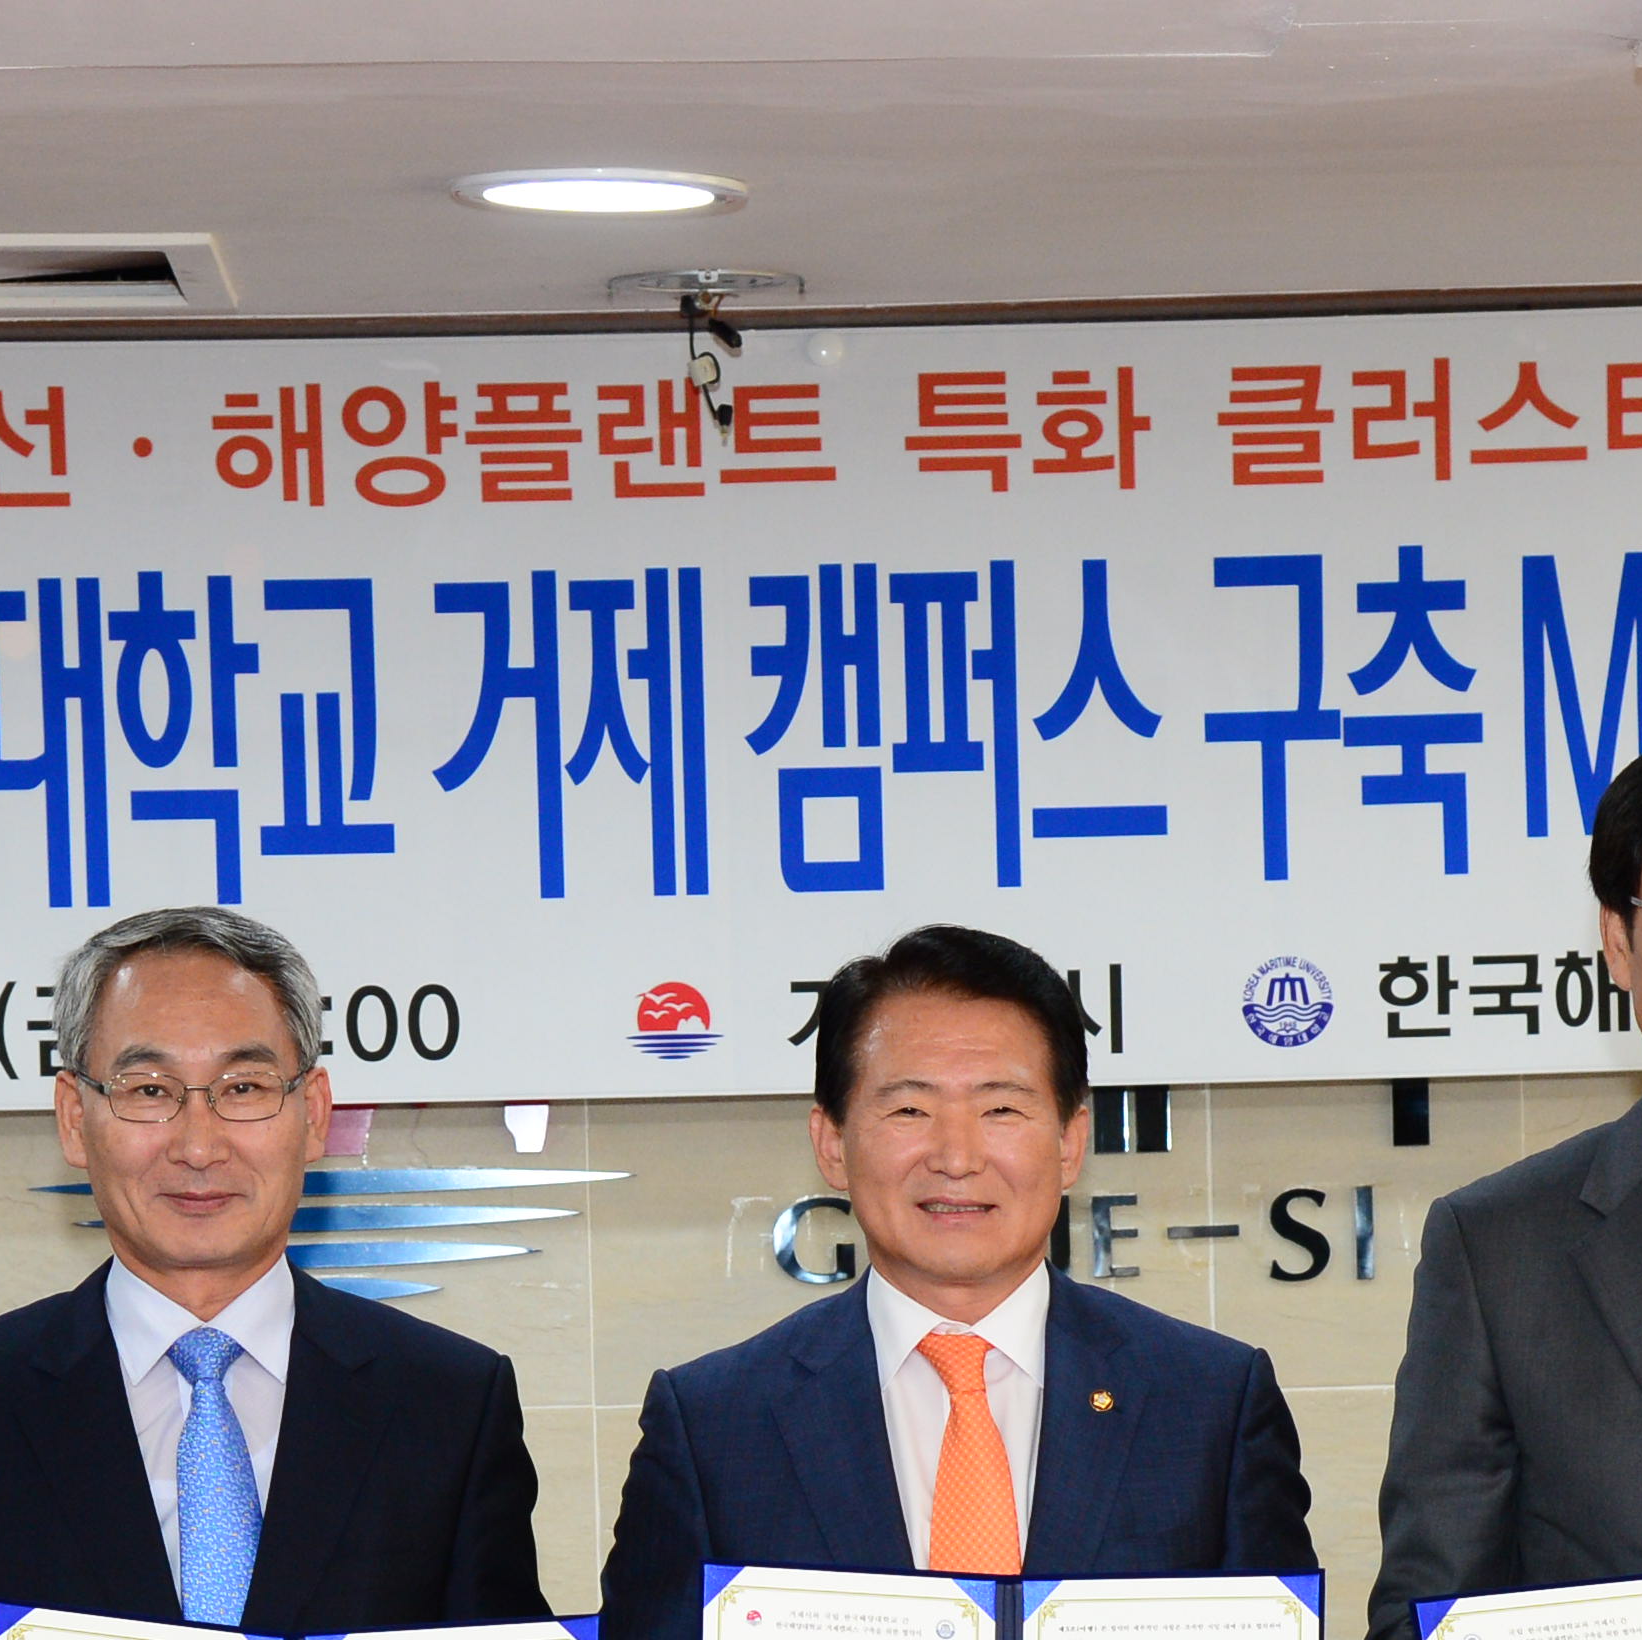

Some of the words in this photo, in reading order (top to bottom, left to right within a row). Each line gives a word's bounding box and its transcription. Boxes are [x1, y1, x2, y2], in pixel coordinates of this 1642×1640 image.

[211, 377, 838, 509] 해양플랜트
[904, 366, 1153, 494] 특화
[432, 566, 710, 900] 거제
[744, 558, 1169, 894] 캠퍼스
[1203, 544, 1484, 882] 구축
